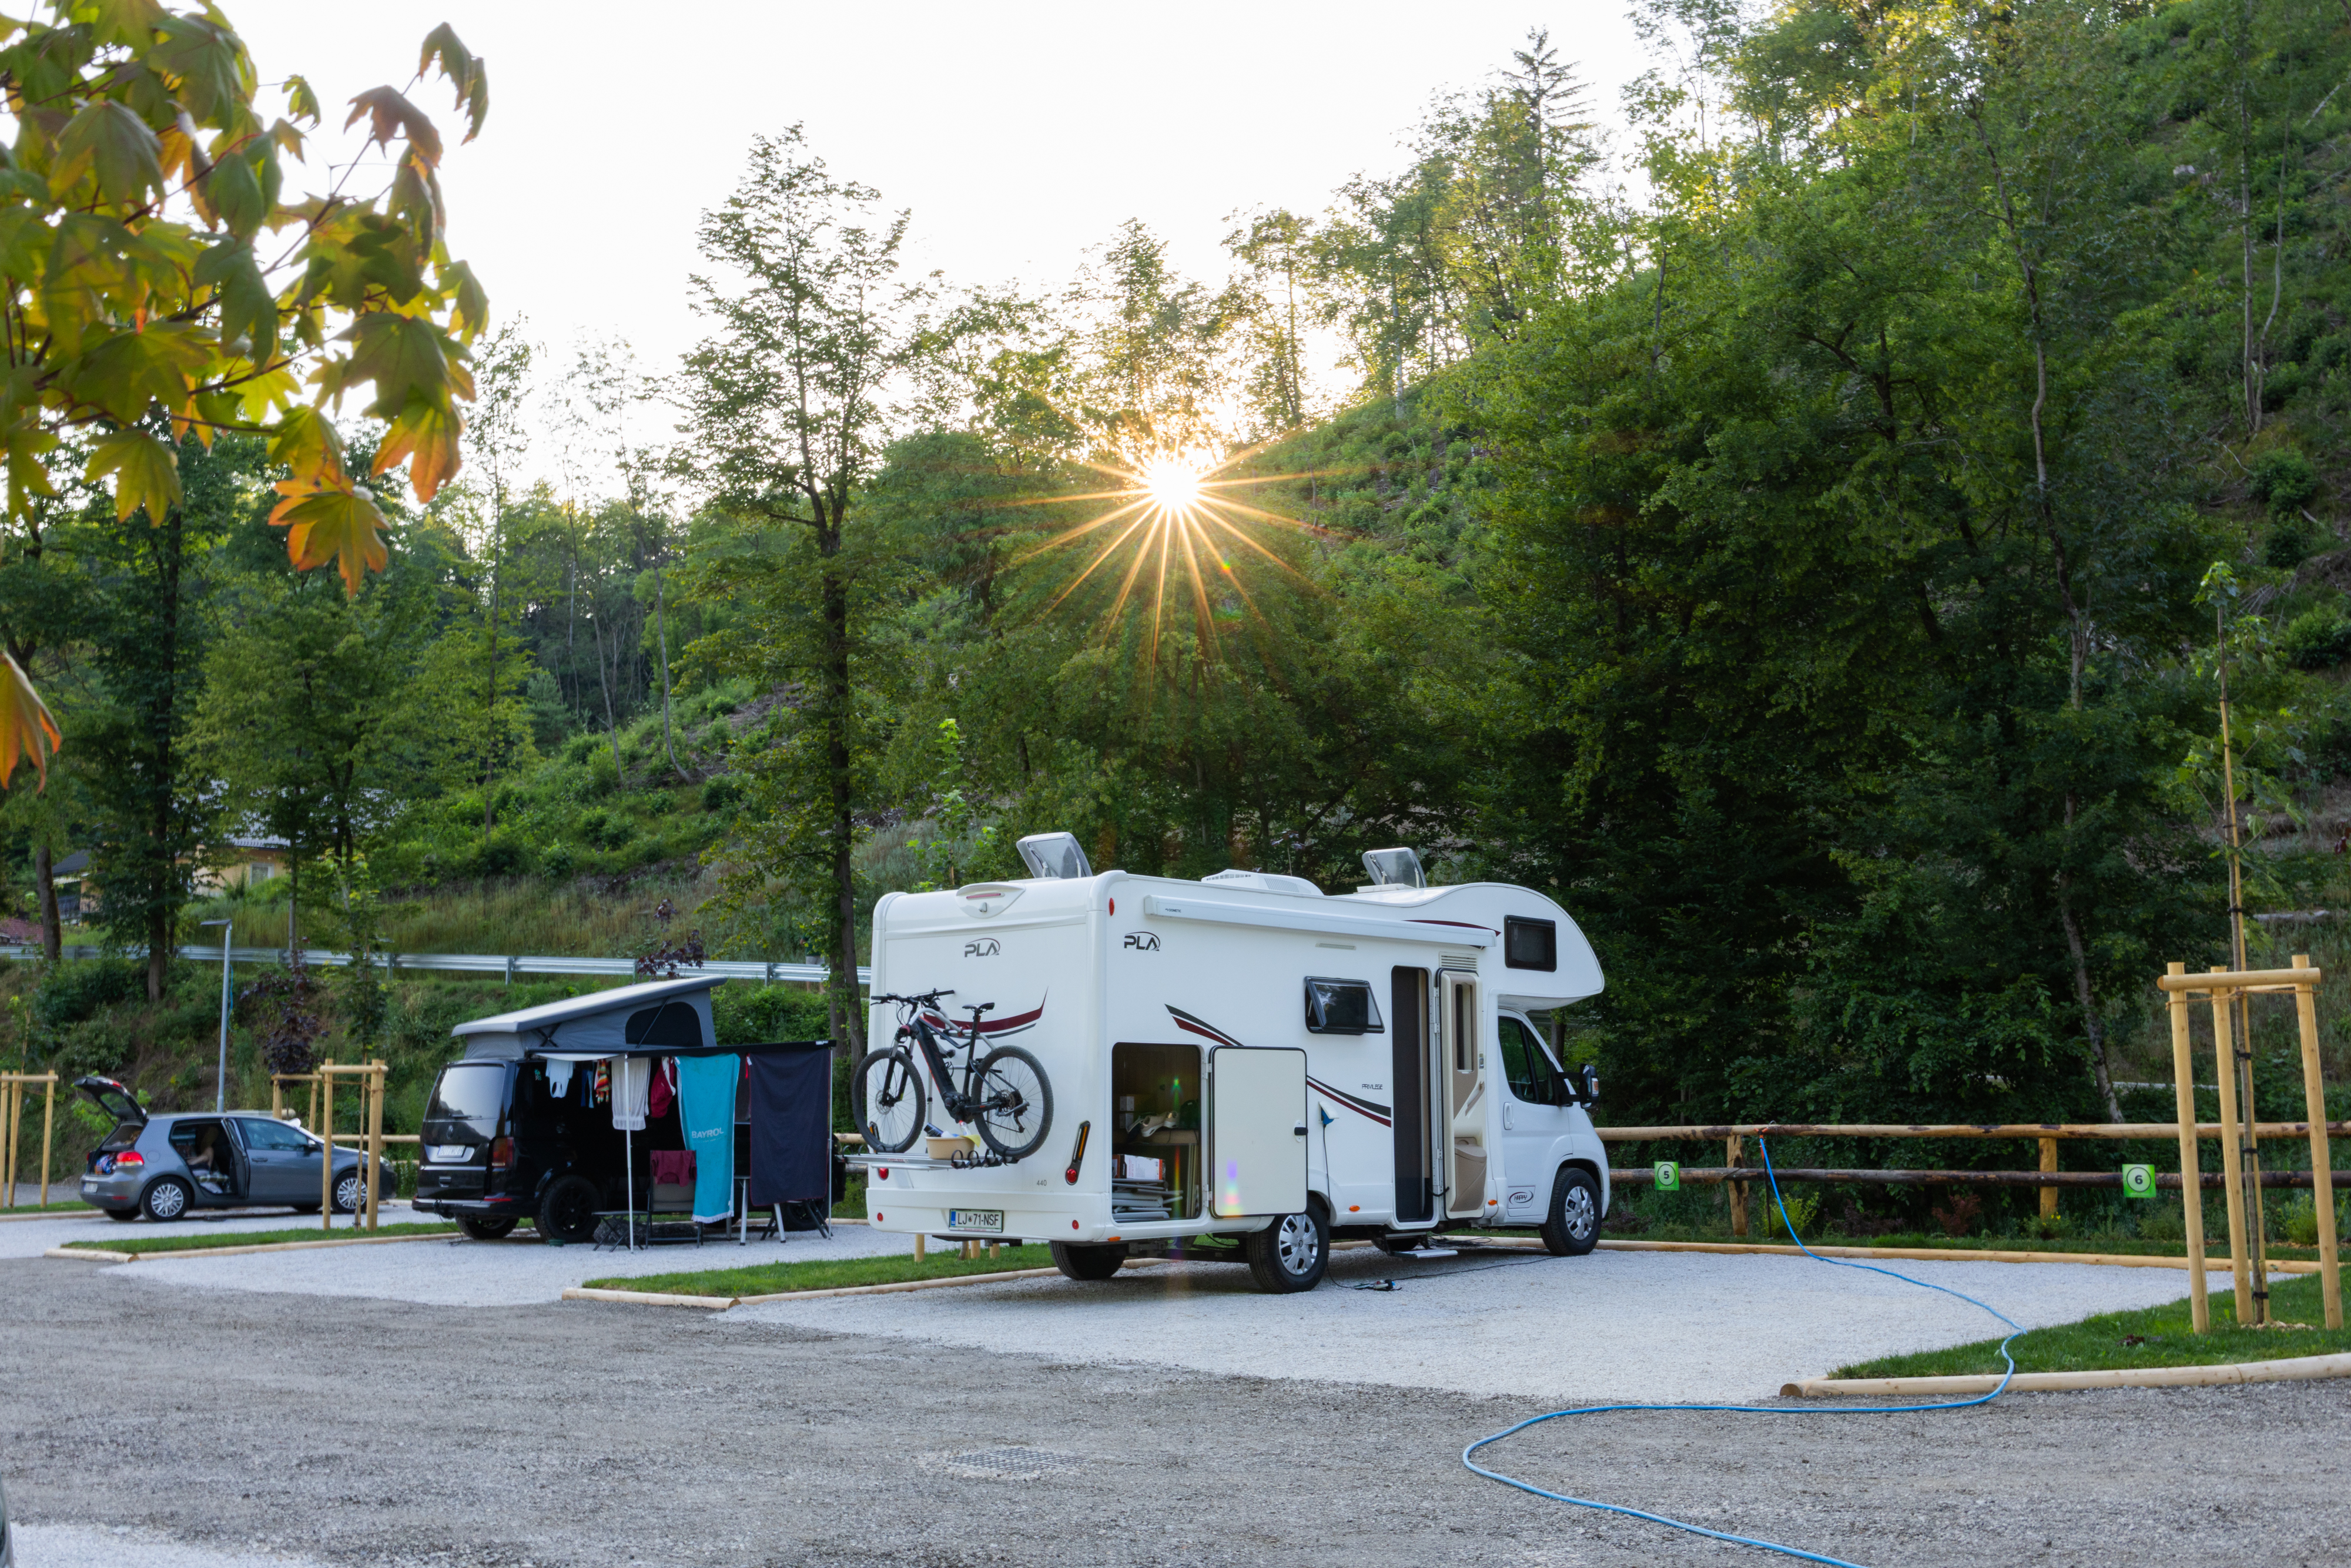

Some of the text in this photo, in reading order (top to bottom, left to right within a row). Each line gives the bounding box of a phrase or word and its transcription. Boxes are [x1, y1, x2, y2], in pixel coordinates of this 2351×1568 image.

[1124, 935, 1160, 951] PLA
[964, 942, 999, 957] PLA
[691, 1127, 724, 1138] BAYROL
[1663, 1171, 1670, 1179] 5
[2135, 1174, 2143, 1185] 6
[957, 1213, 999, 1227] LJ 71-NSF
